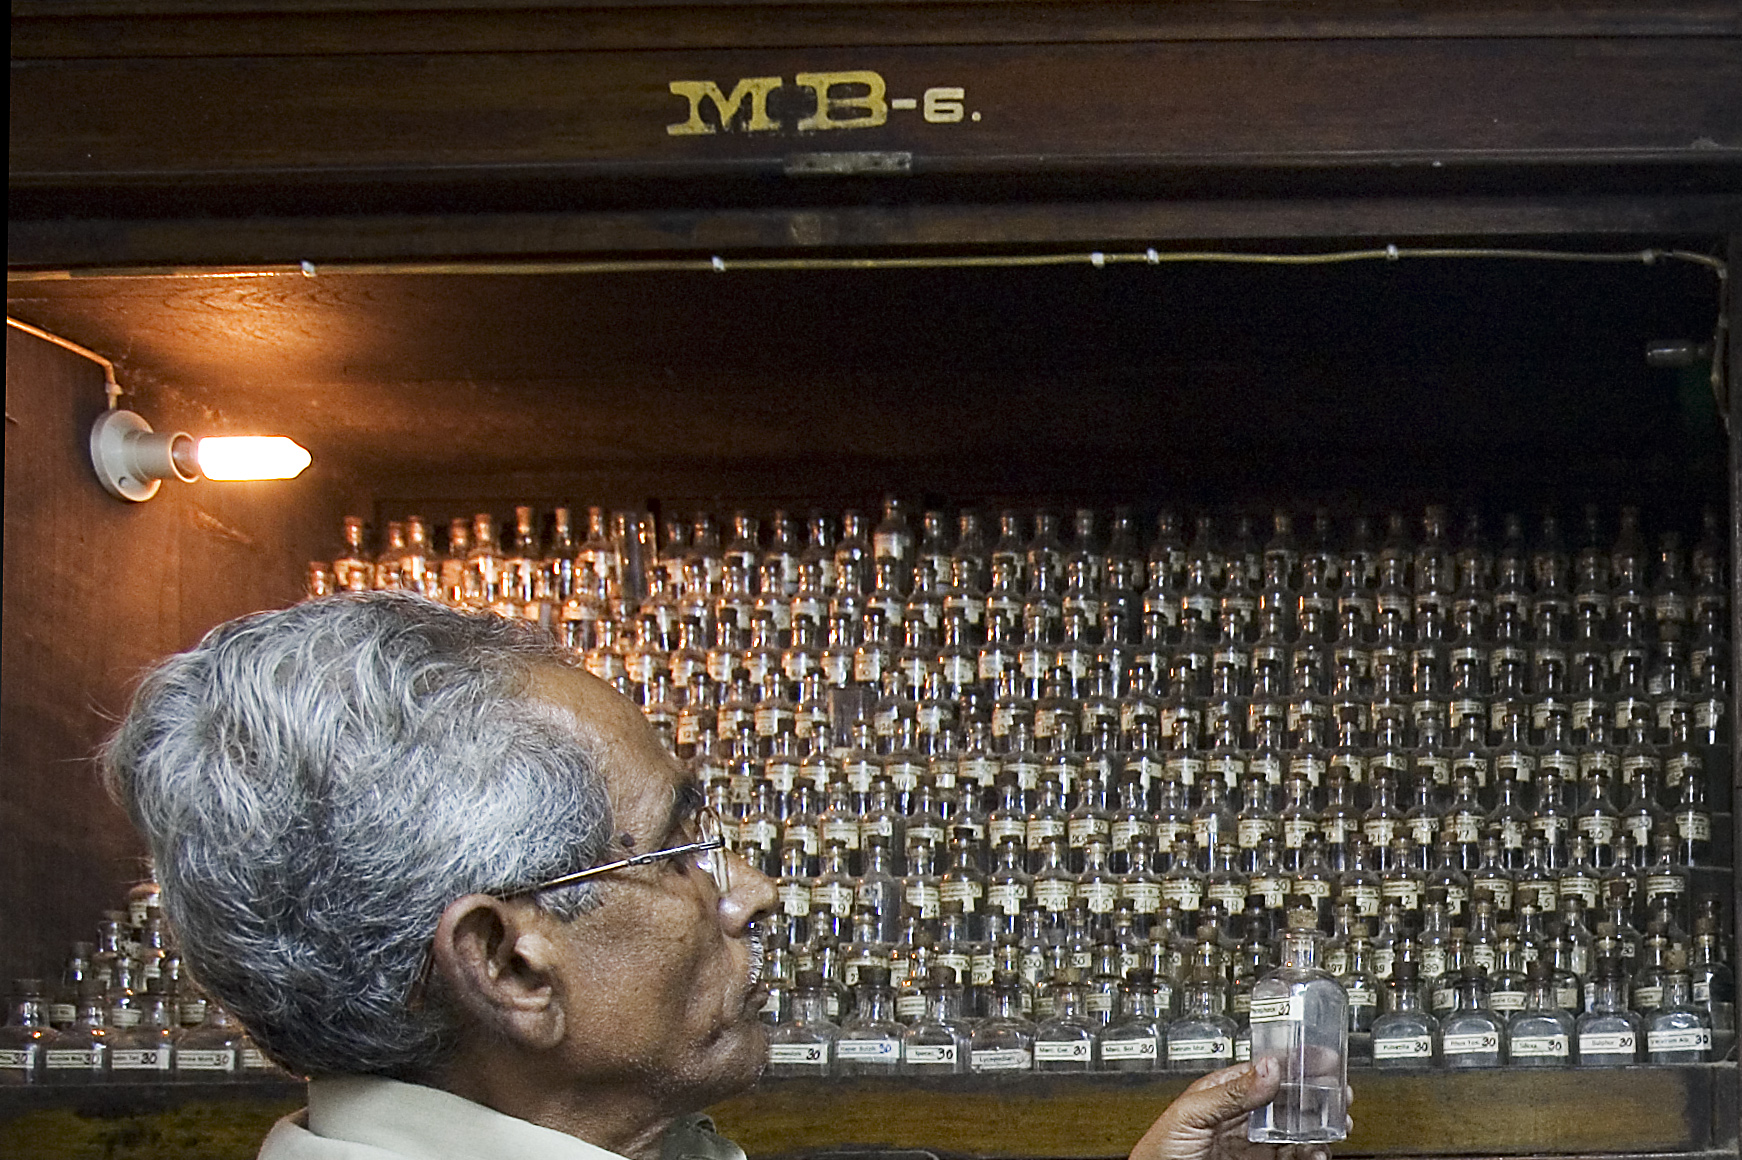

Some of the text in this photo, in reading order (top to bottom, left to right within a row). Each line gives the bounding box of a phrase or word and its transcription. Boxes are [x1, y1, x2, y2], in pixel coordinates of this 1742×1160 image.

[1273, 880, 1287, 892] 30
[1482, 1036, 1496, 1047] 30
[1619, 1037, 1633, 1047] 30
[1695, 1034, 1709, 1045] 30
[1074, 1045, 1087, 1056] 30
[1140, 1043, 1155, 1054] 30
[1211, 1042, 1225, 1054] 30
[1414, 1041, 1428, 1052] 30
[1548, 1041, 1562, 1051] 30
[141, 1052, 158, 1065] 30
[806, 1048, 821, 1061] 30
[937, 1047, 954, 1060] 30
